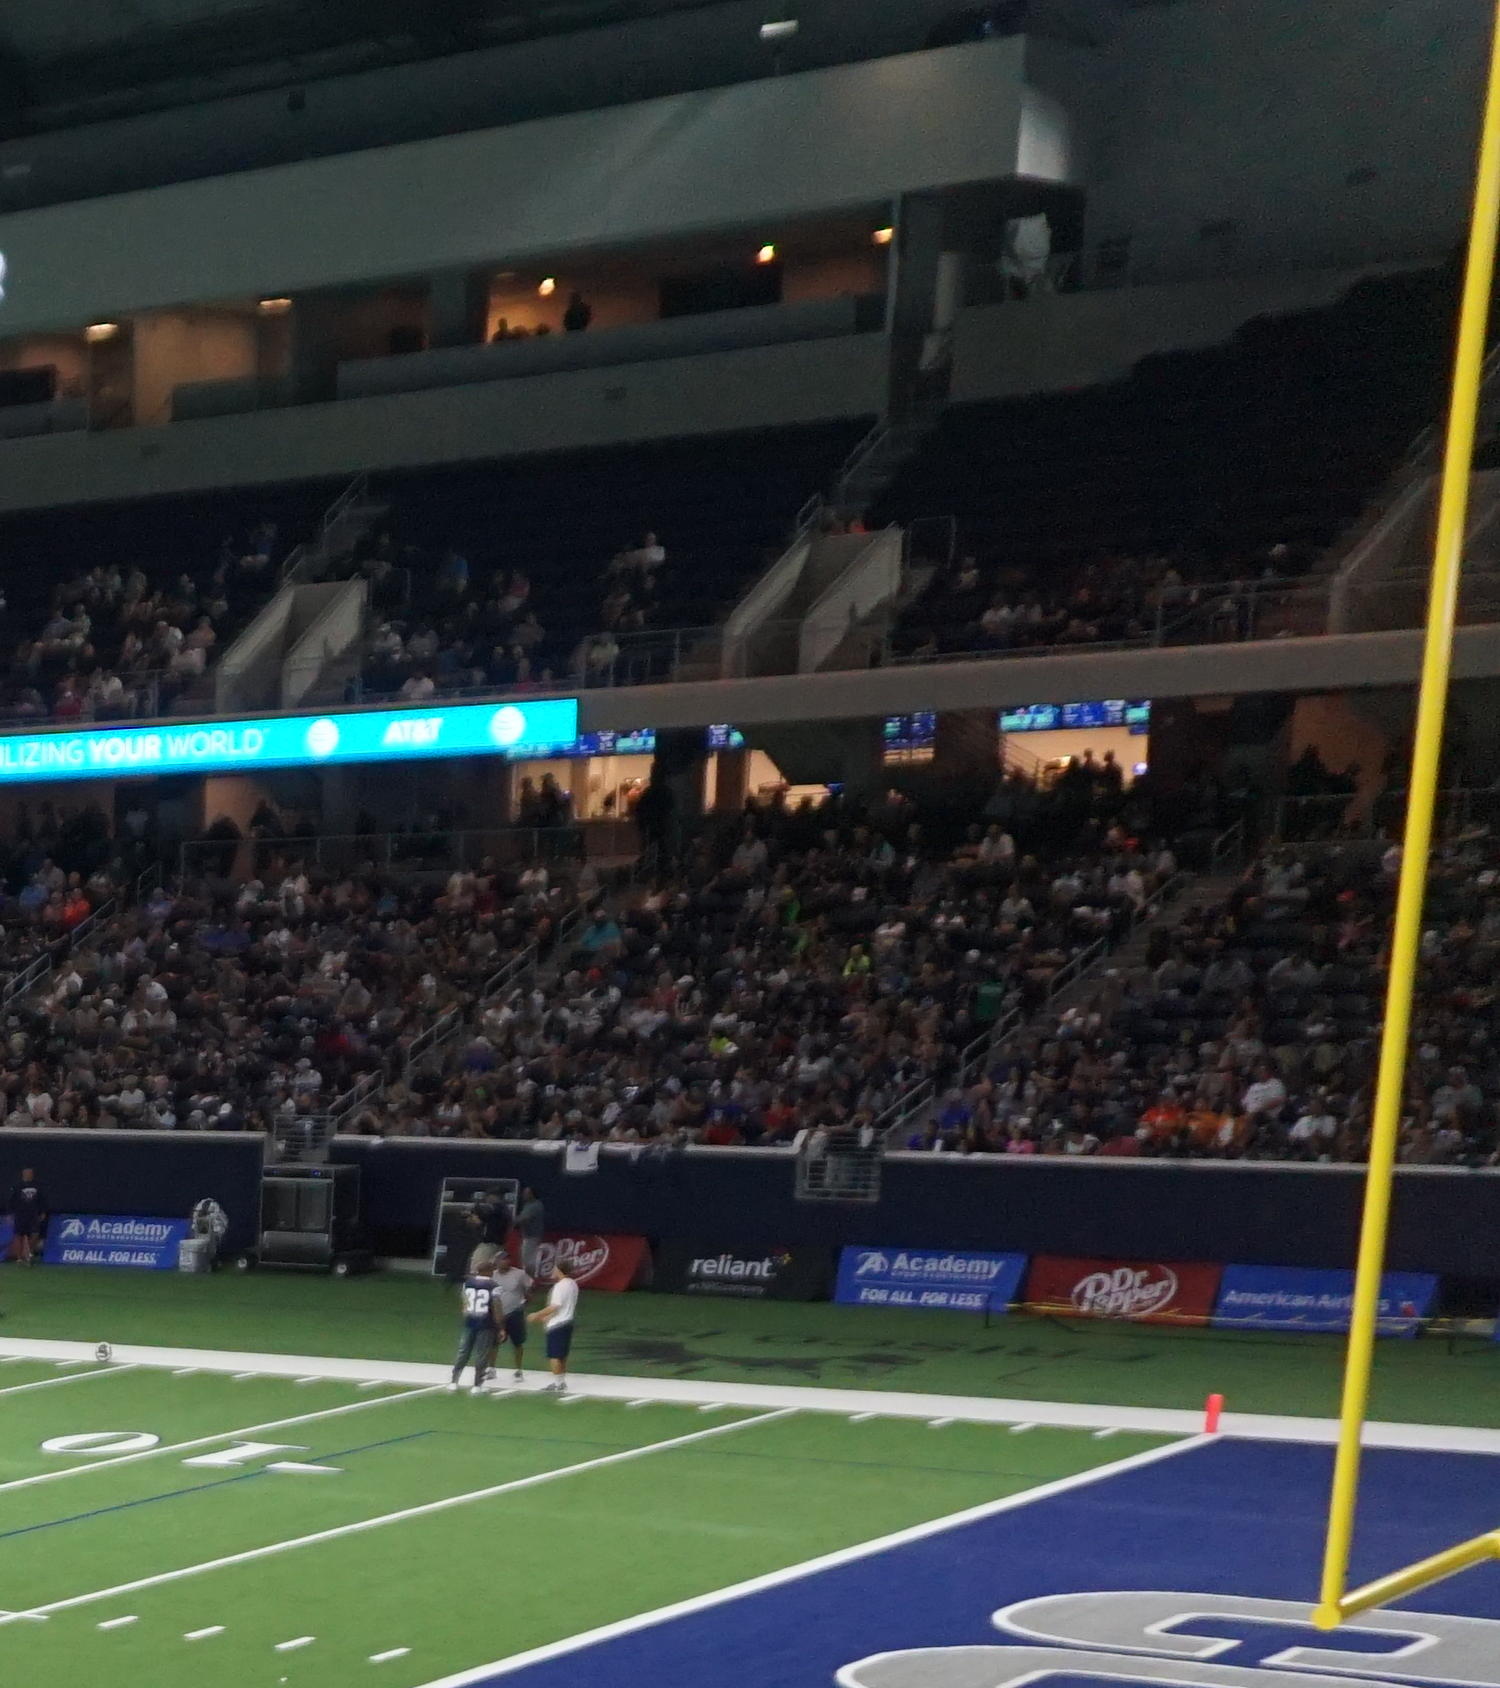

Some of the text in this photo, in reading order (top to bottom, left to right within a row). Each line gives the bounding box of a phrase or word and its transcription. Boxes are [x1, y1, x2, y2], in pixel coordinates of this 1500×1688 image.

[383, 717, 443, 743] AT&T
[87, 734, 161, 763] YOUR
[166, 728, 263, 757] WORLD
[88, 1219, 173, 1240] Academy
[63, 1250, 84, 1261] FOR
[108, 1251, 130, 1263] FOR
[690, 1254, 772, 1278] reliant
[893, 1253, 1003, 1278] Academy
[1112, 1268, 1148, 1292] Dr
[1080, 1273, 1169, 1313] Pepper
